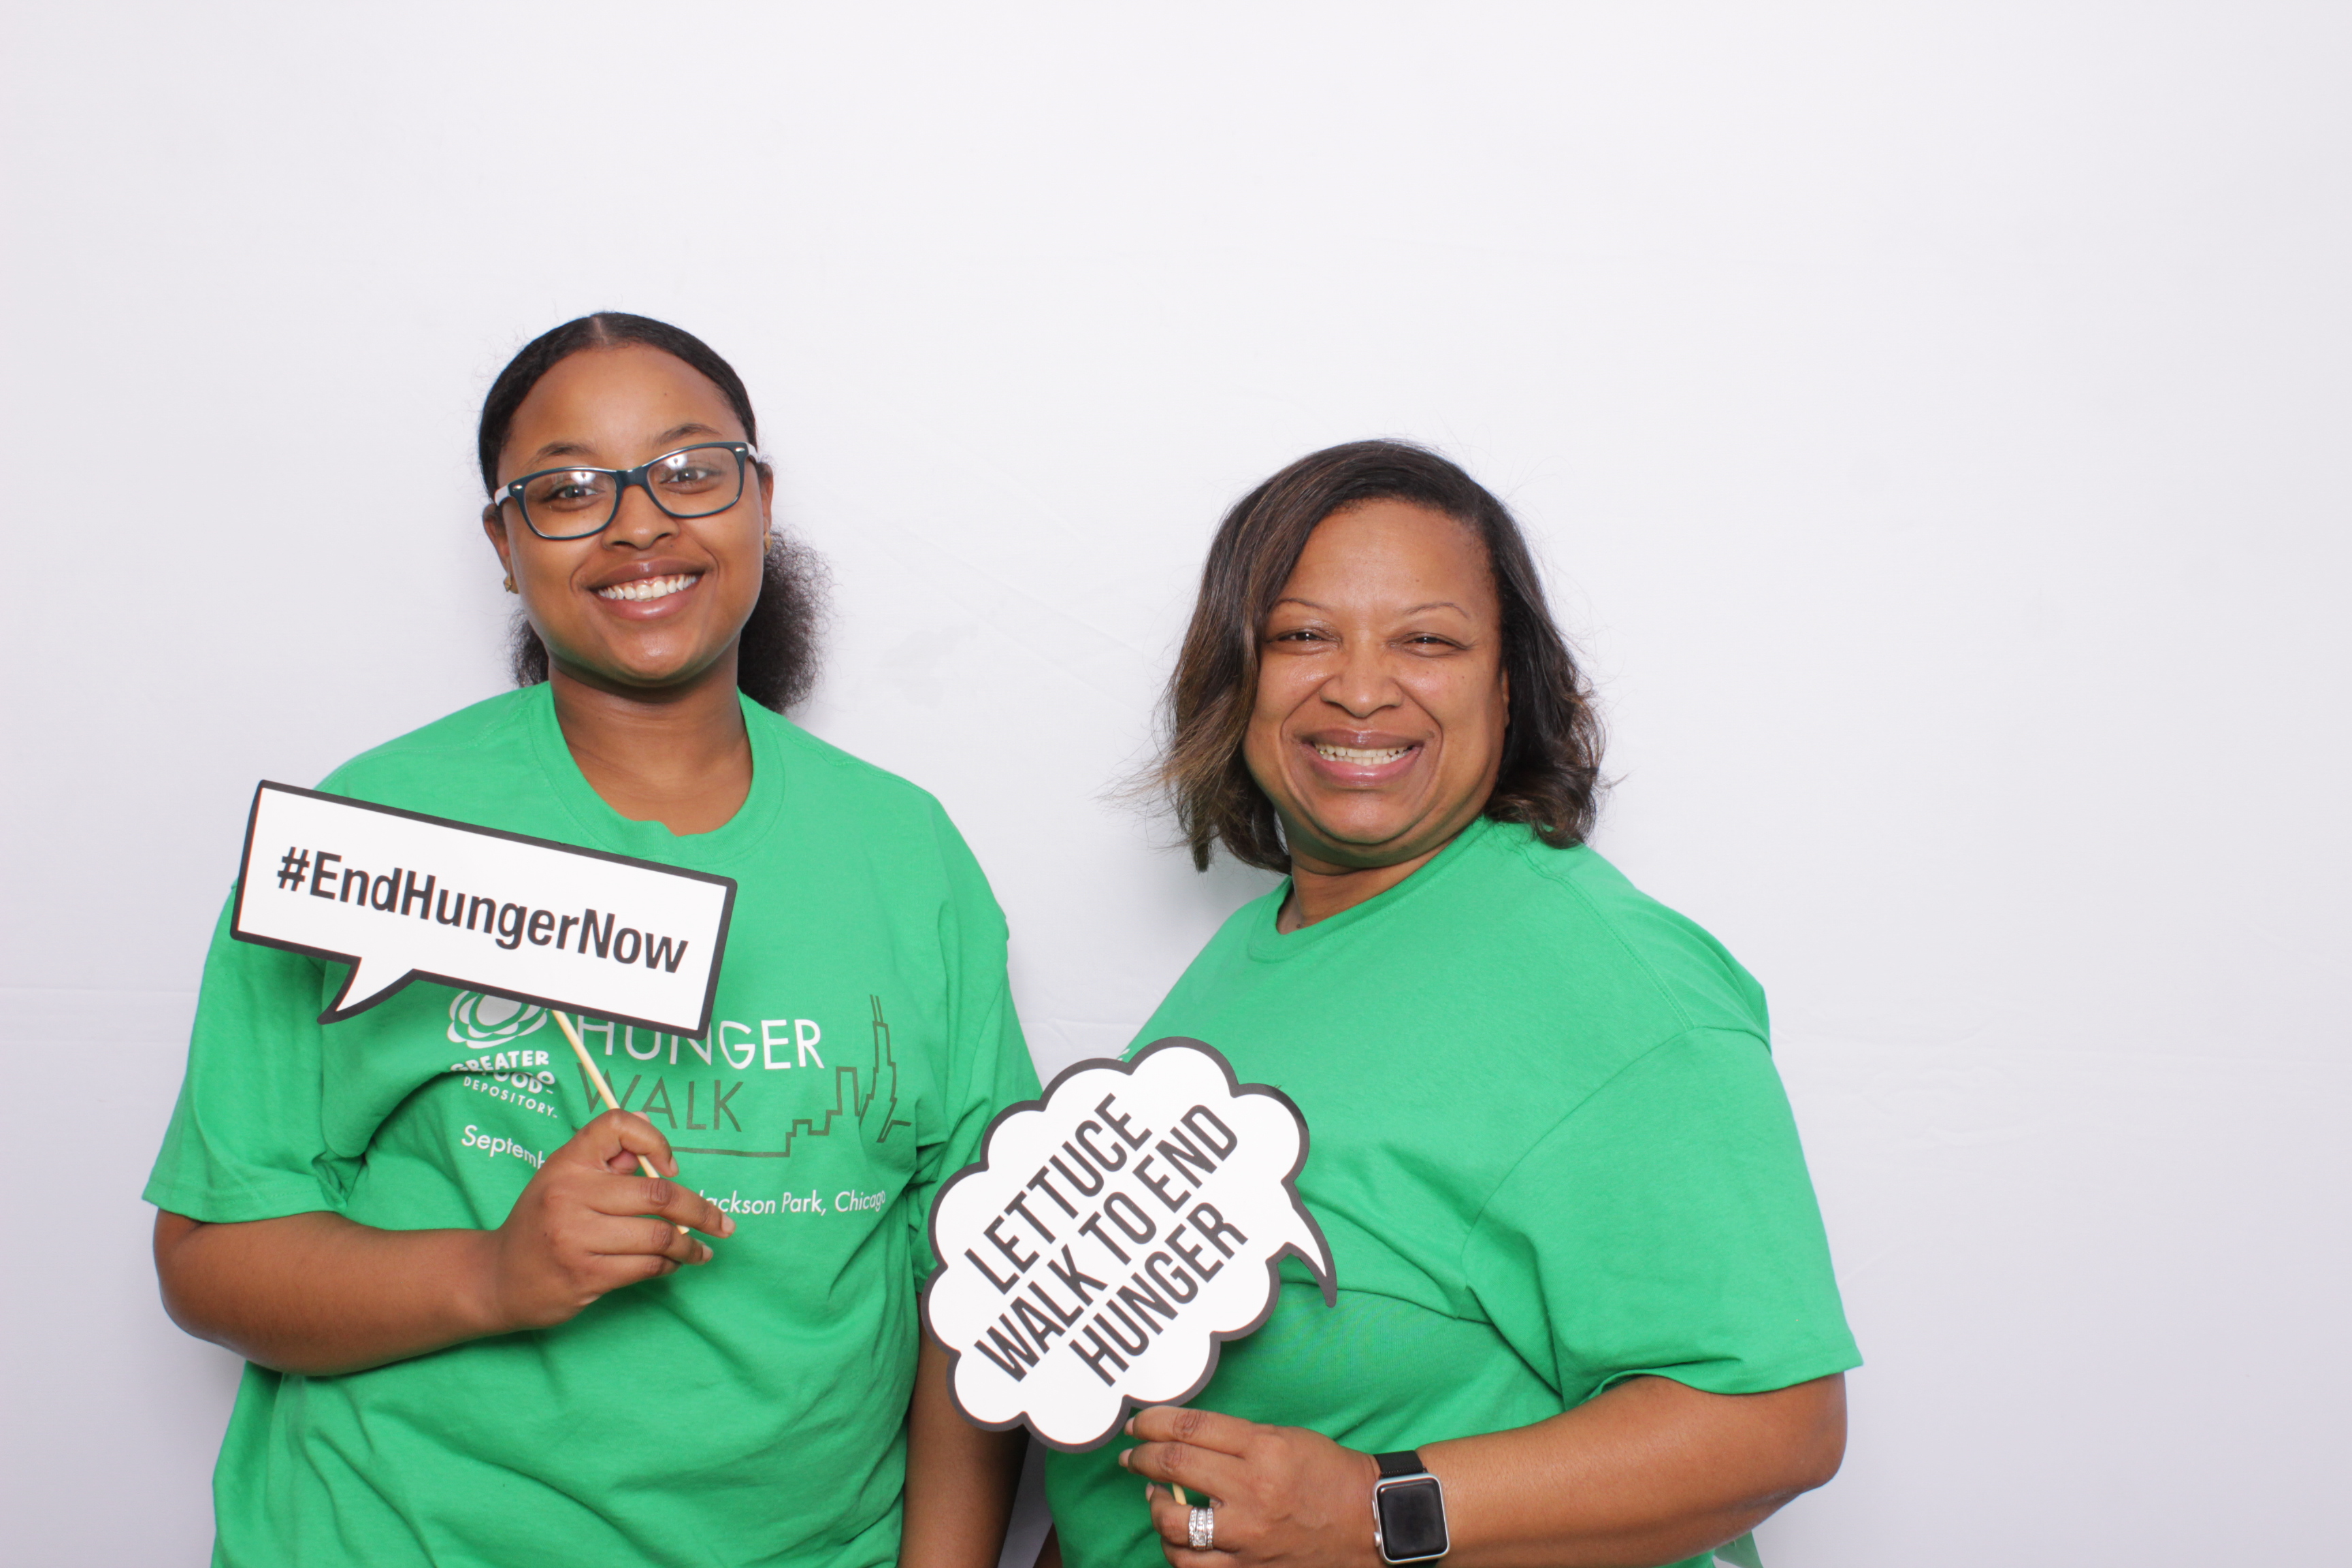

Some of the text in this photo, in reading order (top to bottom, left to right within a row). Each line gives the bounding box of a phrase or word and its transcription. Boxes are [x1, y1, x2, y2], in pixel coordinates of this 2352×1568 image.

[277, 847, 689, 973] #EndHungerNow
[577, 1015, 826, 1071] HUNGER
[463, 1076, 555, 1117] DEPOSITORY
[576, 1062, 744, 1132] WALK
[781, 1189, 827, 1216] Park,
[834, 1189, 886, 1213] Chicago
[964, 1093, 1152, 1296] LETTUCE
[974, 1105, 1237, 1382] WALK TO END
[1068, 1203, 1248, 1387] HUNGER
